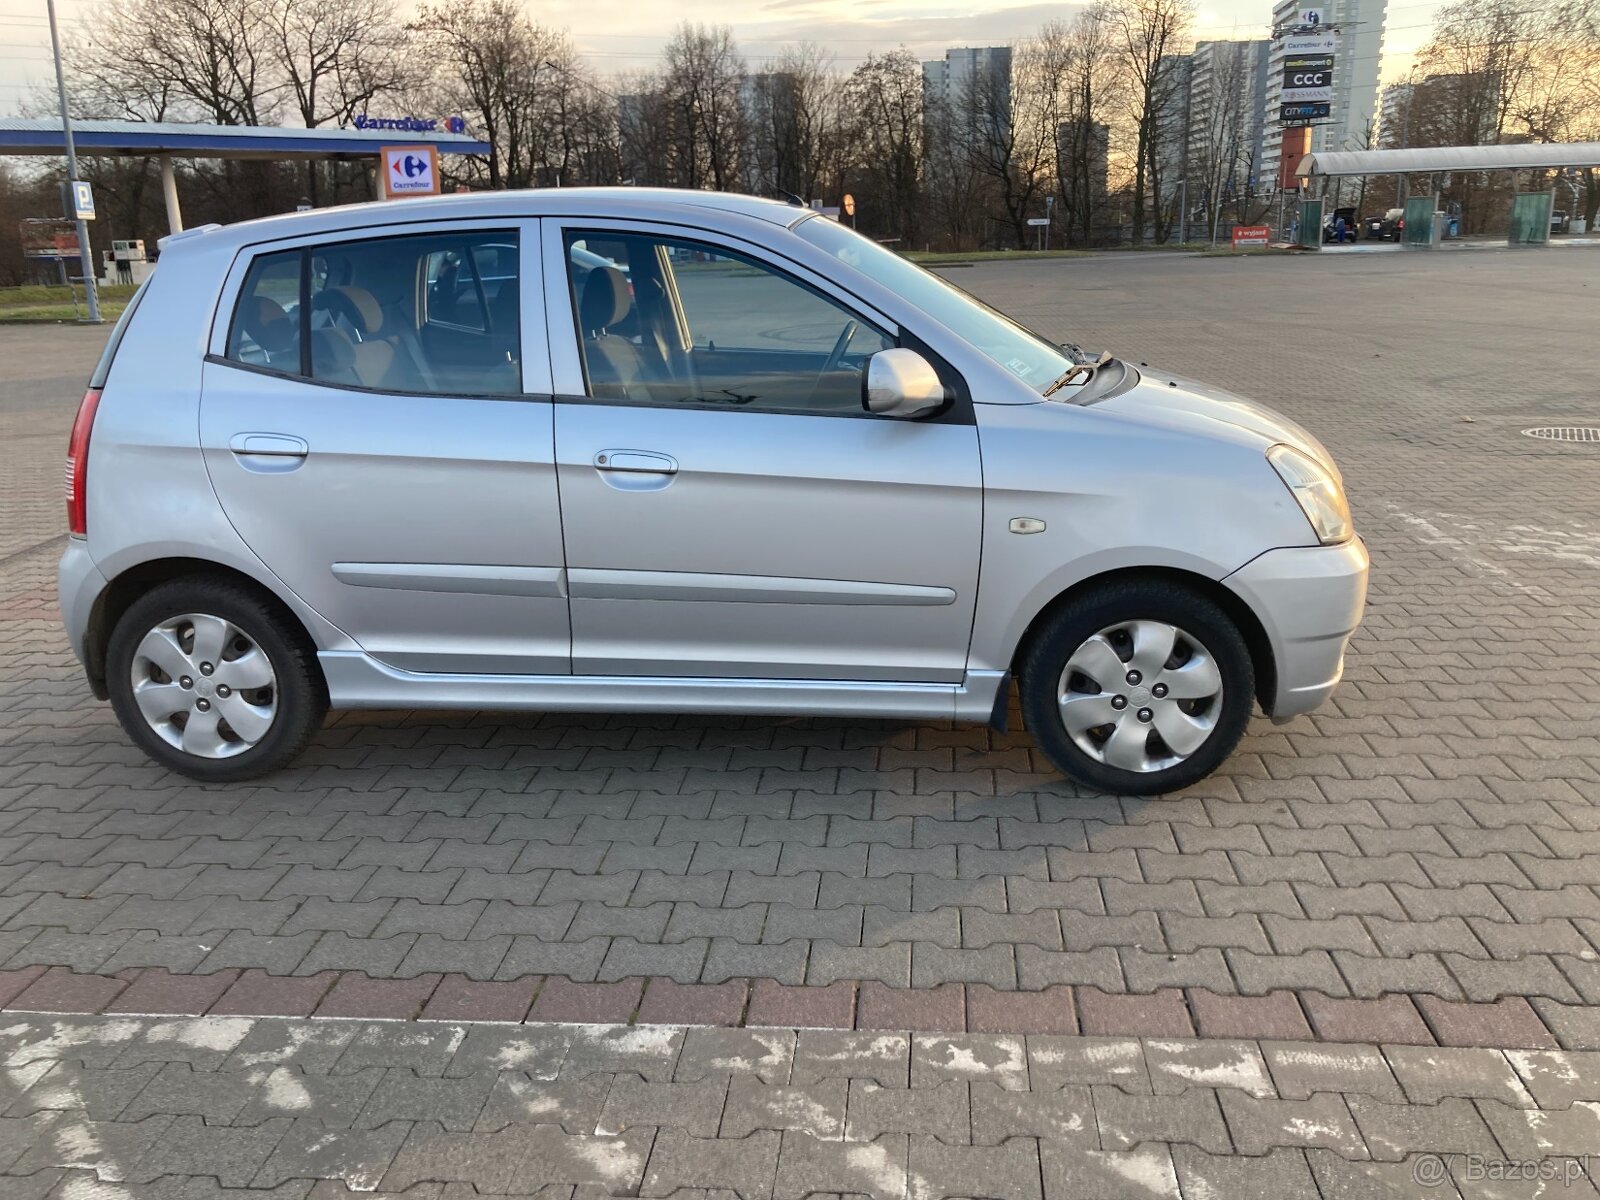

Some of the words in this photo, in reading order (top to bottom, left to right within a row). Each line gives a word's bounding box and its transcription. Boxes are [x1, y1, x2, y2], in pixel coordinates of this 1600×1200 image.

[1293, 73, 1323, 85] CCC
[355, 115, 438, 131] Carrefour
[393, 181, 430, 189] Carrefour
[78, 186, 89, 208] P
